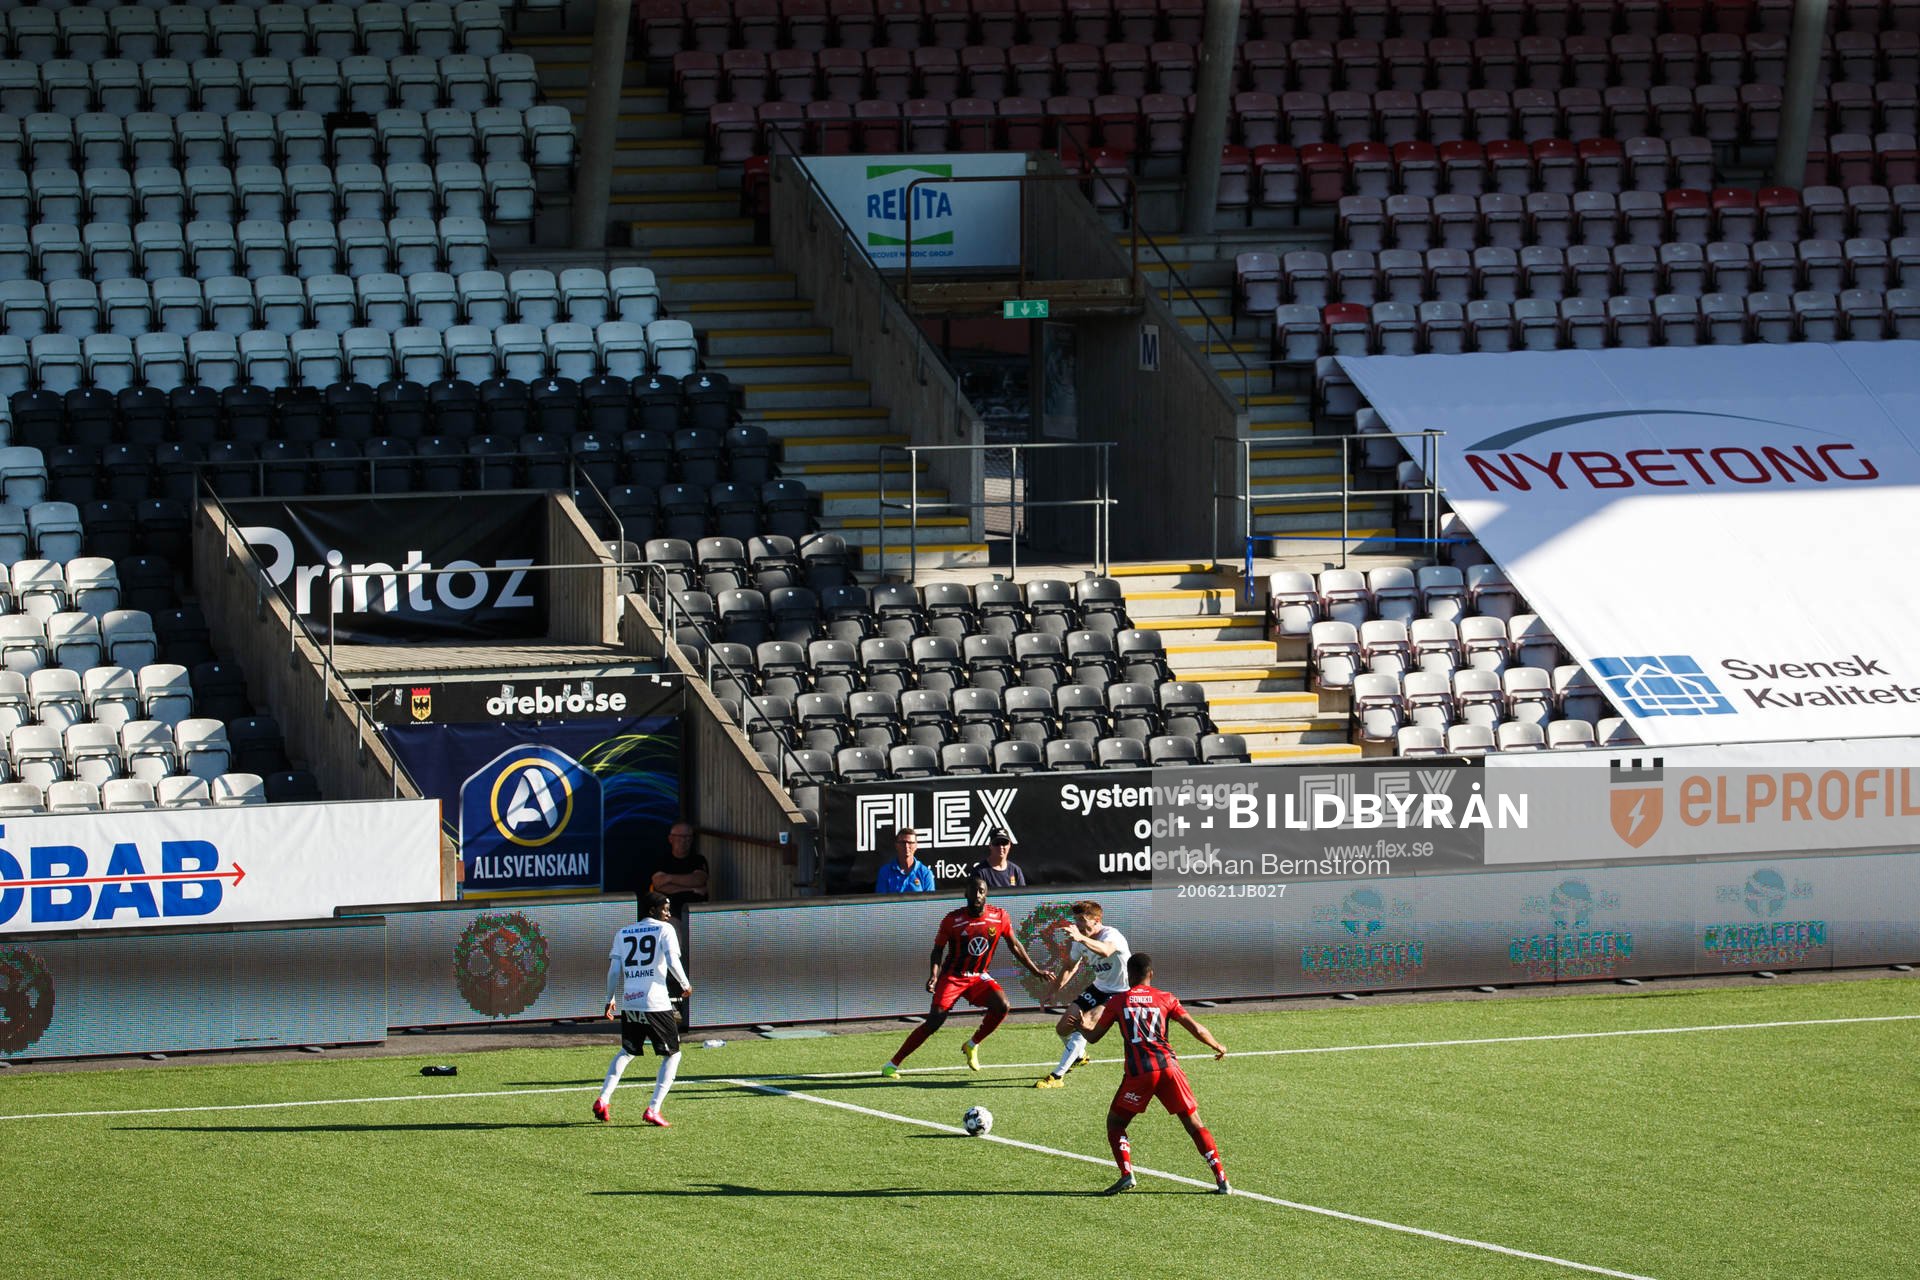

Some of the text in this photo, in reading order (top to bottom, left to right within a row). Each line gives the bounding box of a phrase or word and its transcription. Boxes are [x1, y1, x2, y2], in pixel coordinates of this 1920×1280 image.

[867, 187, 952, 220] RELITA
[1143, 333, 1157, 365] M
[1465, 443, 1879, 491] NYBETONG
[234, 526, 534, 614] Printoz
[1721, 654, 1891, 680] Svensk
[1061, 779, 1259, 816] Systemväggar
[856, 788, 1018, 852] FLEX
[1134, 812, 1184, 839] och
[1099, 843, 1221, 873] undertak
[1324, 839, 1434, 860] www.flex.se
[473, 853, 590, 879] ALLSVENSKAN
[623, 935, 656, 967] 29
[1124, 1007, 1160, 1043] 77
